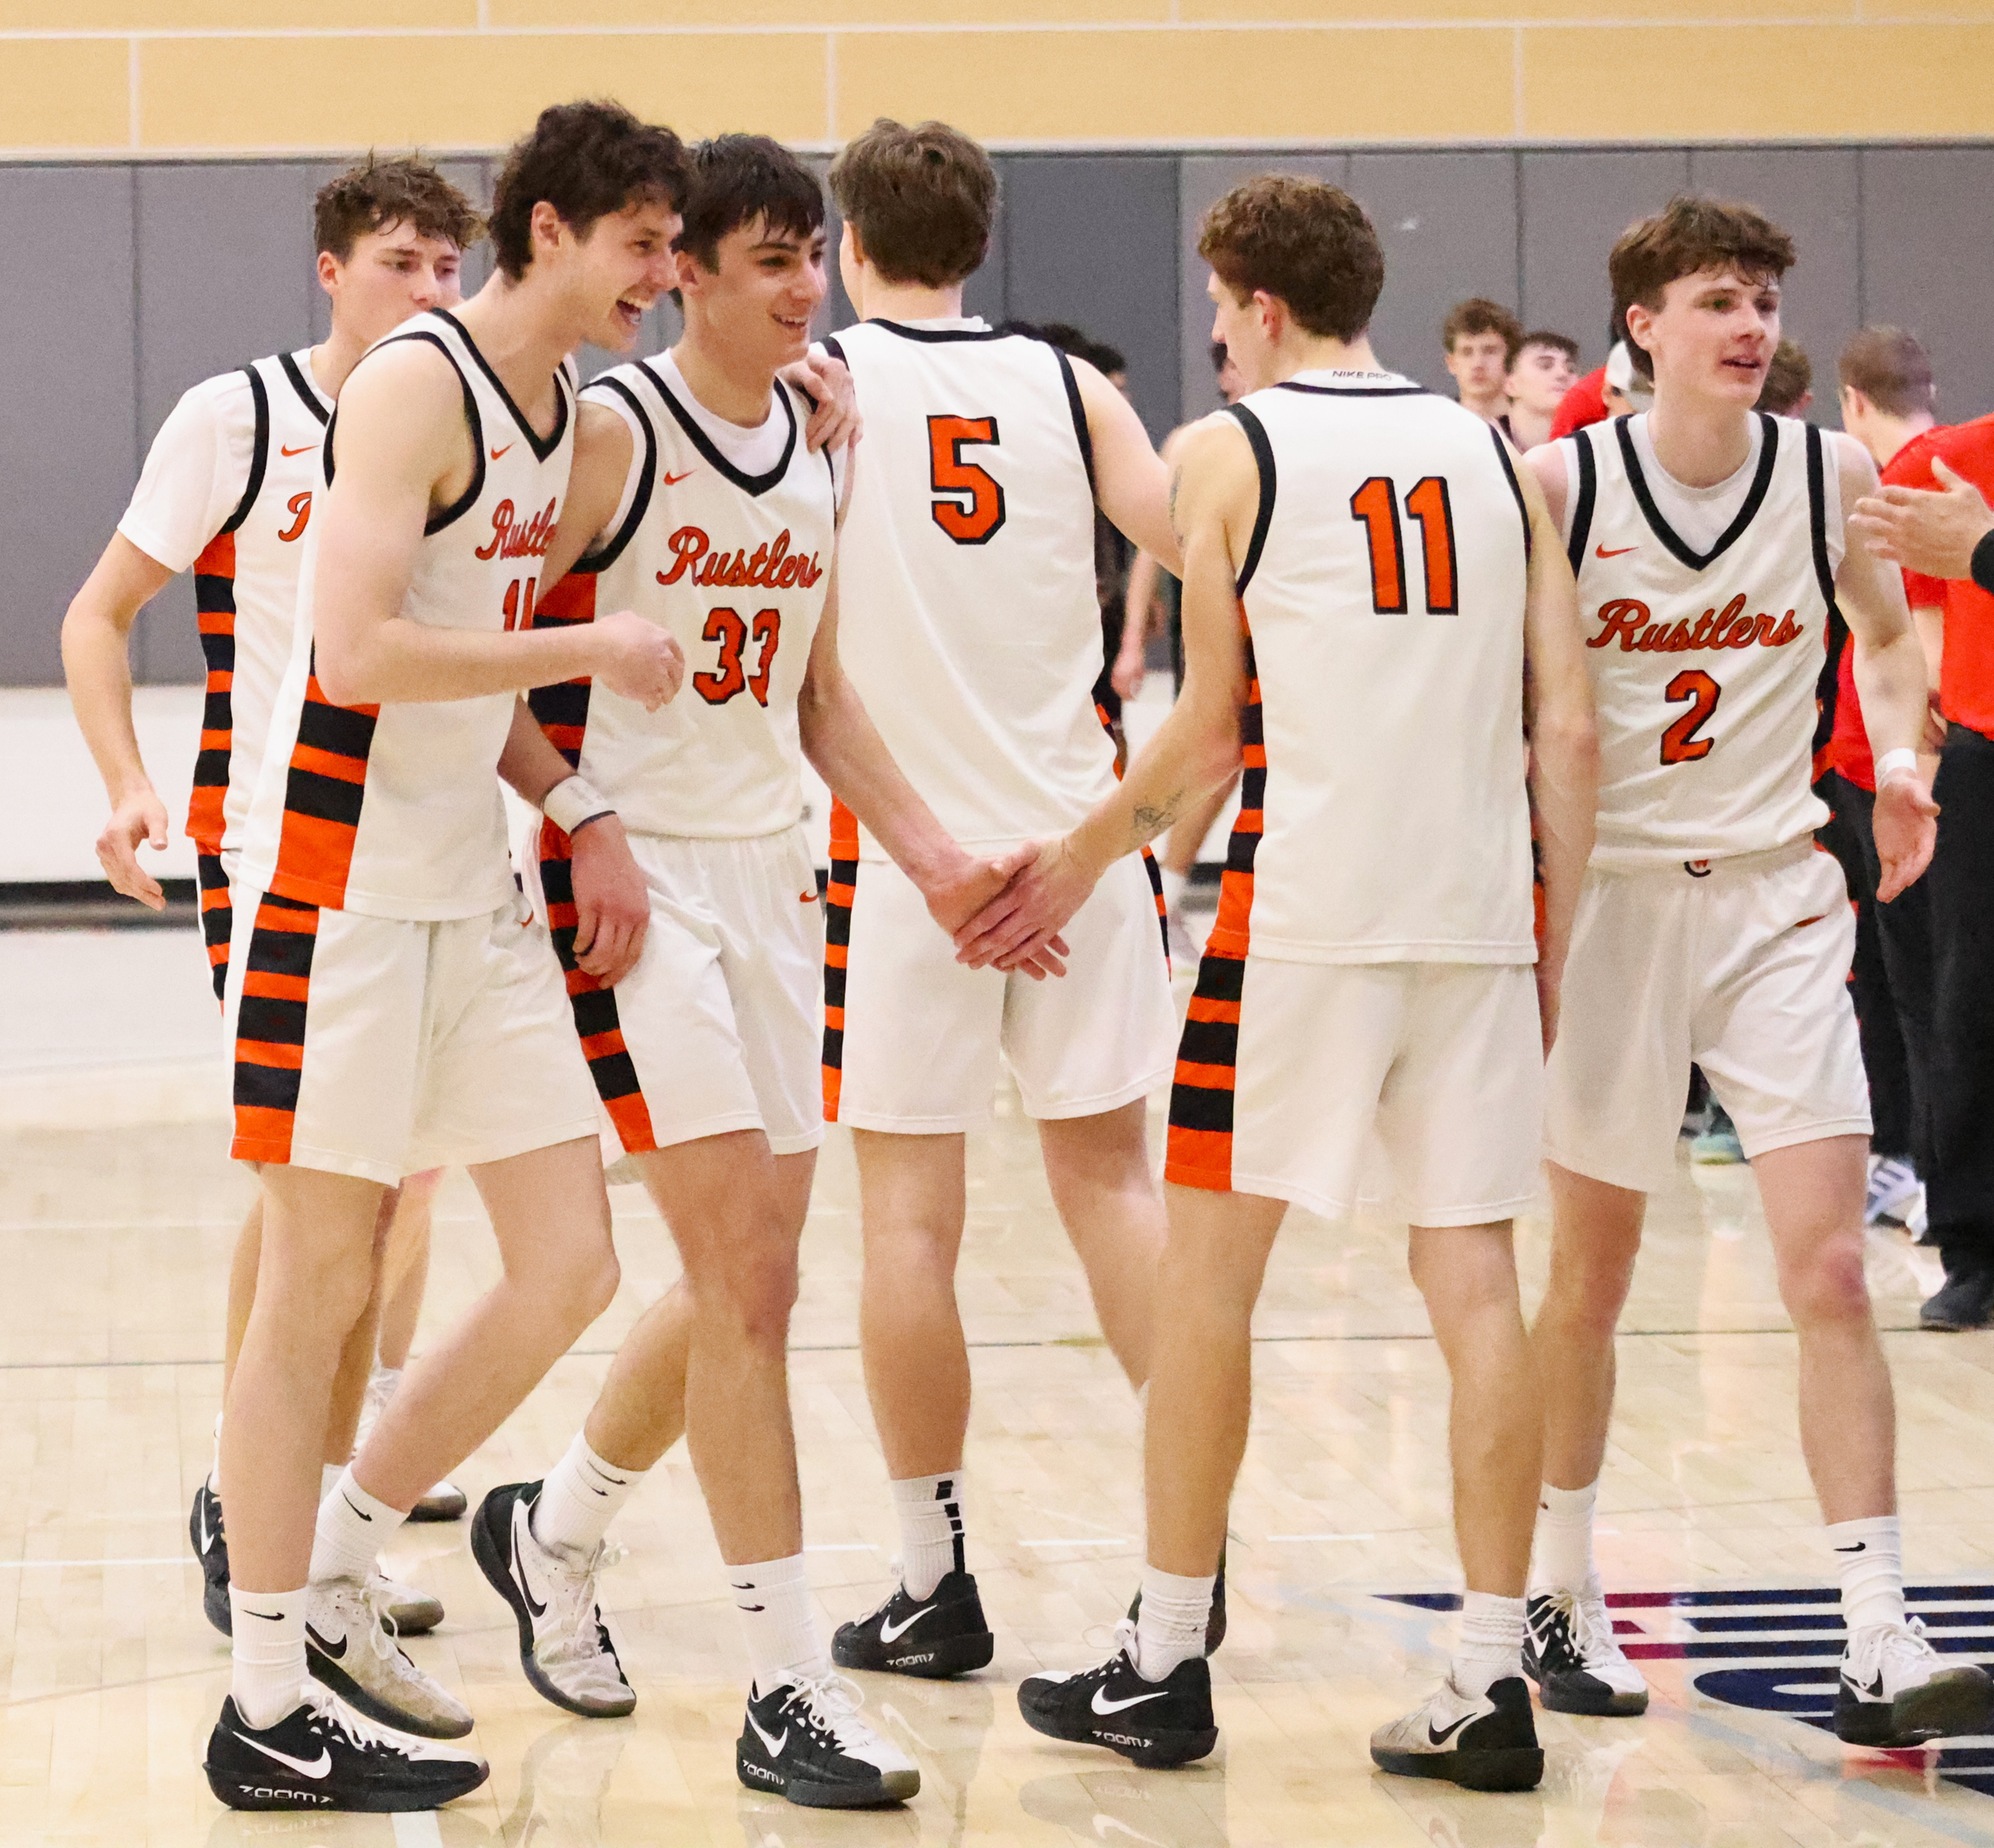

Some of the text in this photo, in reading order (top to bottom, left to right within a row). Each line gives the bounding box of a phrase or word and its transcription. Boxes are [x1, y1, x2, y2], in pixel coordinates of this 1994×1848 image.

[1332, 370, 1392, 381] NIKE PRO
[926, 414, 1006, 545] 5
[656, 526, 823, 588] Rustlers
[1350, 476, 1459, 616] 11
[693, 607, 781, 707] 33
[1586, 593, 1804, 652] Rustlers
[1660, 669, 1721, 766] 2
